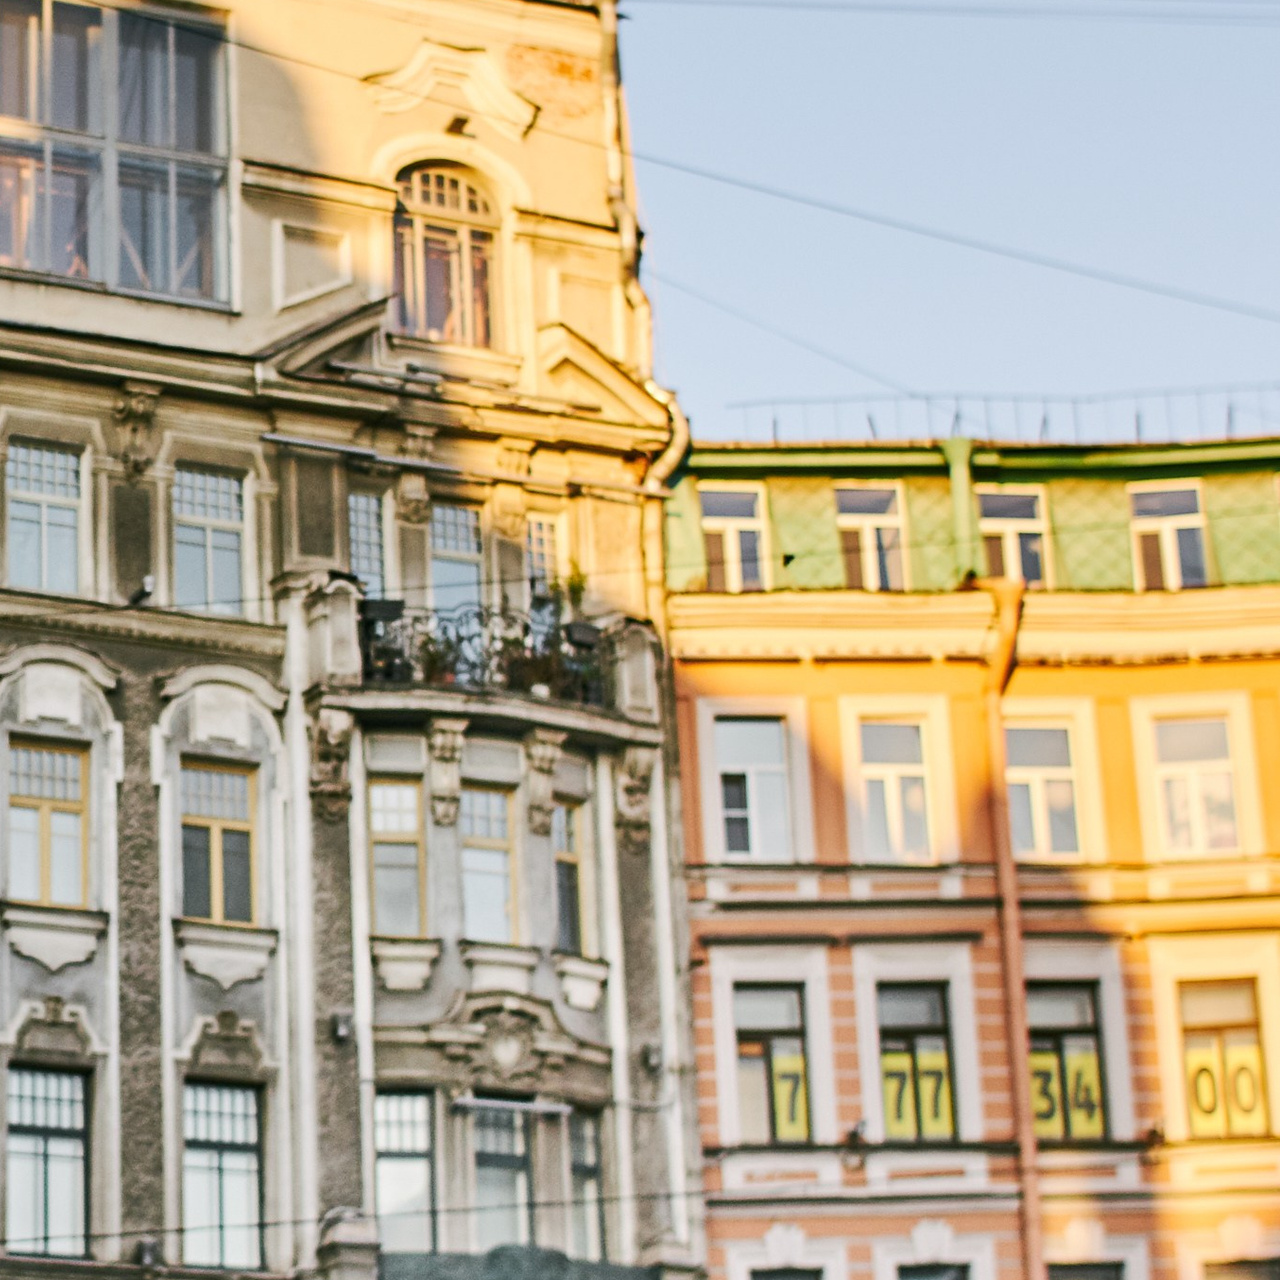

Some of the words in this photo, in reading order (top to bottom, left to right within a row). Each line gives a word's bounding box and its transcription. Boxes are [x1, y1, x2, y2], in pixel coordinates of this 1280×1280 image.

[779, 1071, 801, 1123] 7
[883, 1070, 943, 1120] 77
[1031, 1069, 1096, 1121] 34
[1195, 1067, 1256, 1114] 00
